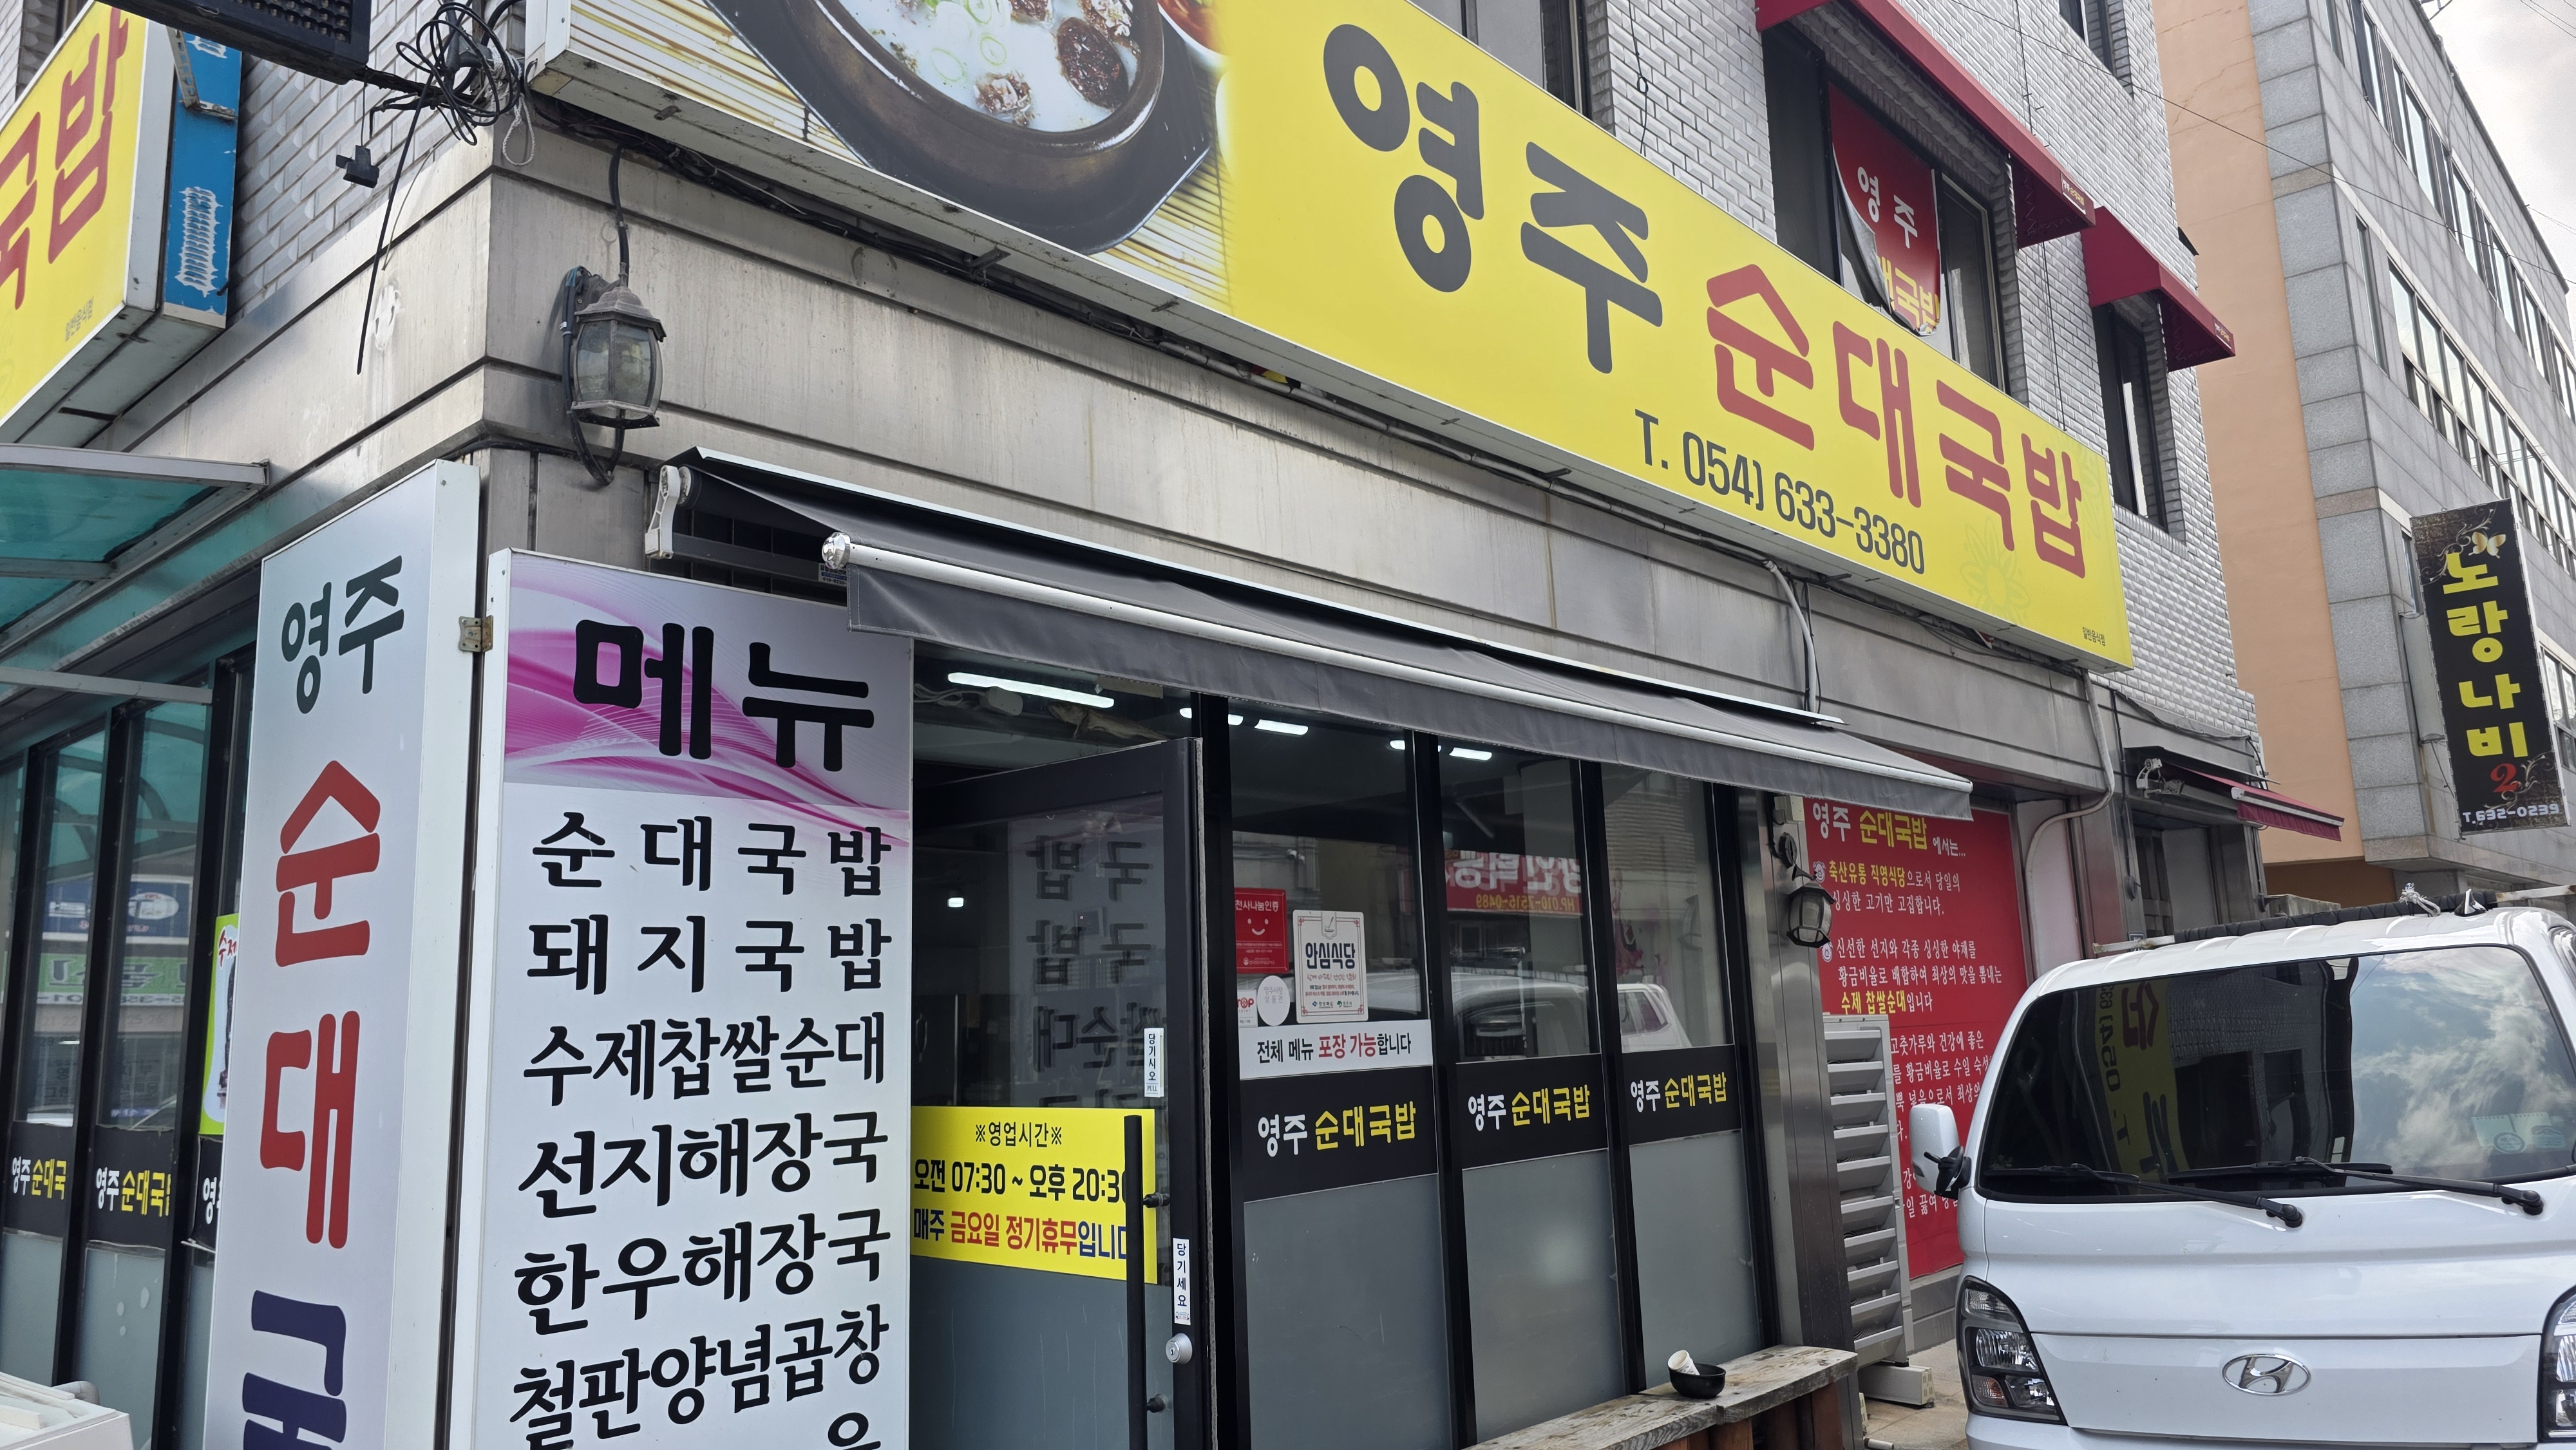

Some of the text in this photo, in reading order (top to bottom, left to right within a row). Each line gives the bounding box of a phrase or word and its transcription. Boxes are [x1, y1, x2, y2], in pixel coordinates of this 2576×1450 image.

[1857, 166, 1918, 249] 영주
[1323, 24, 2086, 579] 영주 순대국밥
[1634, 408, 1925, 575] T. 054) 633-3380
[281, 555, 404, 715] 영주
[2082, 626, 2106, 646] 일반음식점
[2443, 552, 2528, 758] 노랑나비
[573, 619, 875, 772] 메뉴
[2490, 763, 2519, 793] 2
[1813, 802, 1851, 842] 영주
[1859, 810, 1927, 850] 순대국밥
[533, 812, 891, 897] 순대국밥
[1829, 860, 1960, 892] 축산유통 직영식당으로서 당일의
[1235, 899, 1279, 912] 천사나눔인증
[1832, 890, 1944, 916] 싱싱한 고기만 고집합니다.
[527, 914, 892, 995] 돼지국밥
[1305, 943, 1356, 969] 안심식당
[1837, 937, 1976, 959] 신선한 선지와 각종 싱싱한 야채를
[1839, 966, 1888, 987] 황금비율로
[1892, 966, 1927, 986] 배합하여
[1932, 965, 1956, 985] 최상의
[1960, 965, 1976, 984] 맛을
[1841, 991, 1862, 1015] 수제
[524, 1012, 884, 1106] 수제찹쌀순대
[1257, 1032, 1412, 1063] 전체 메뉴 포장 가능합니다
[1891, 1030, 1984, 1056] 고춧가루와 건강에 좋은
[1631, 1072, 1727, 1113] 영주 순대국밥
[1906, 1060, 1951, 1083] 황금비율로
[1954, 1057, 1971, 1078] 수일
[1258, 1100, 1416, 1157] 영주 순대국밥
[1468, 1084, 1590, 1131] 영주 순대국밥
[12, 1156, 66, 1200] 영주 순대국
[518, 1111, 888, 1218] 선지해장국
[914, 1159, 945, 1193] 오전
[952, 1162, 1005, 1194] 07:30
[1030, 1164, 1066, 1201] 오후
[97, 1167, 120, 1211] 영주
[203, 1177, 221, 1224] 영
[914, 1208, 945, 1241] 매주
[951, 1211, 999, 1247] 금요일
[514, 1209, 891, 1335] 한우해장국
[1177, 1243, 1187, 1306] 당기세요
[510, 1303, 889, 1450] 철판양념곱창
